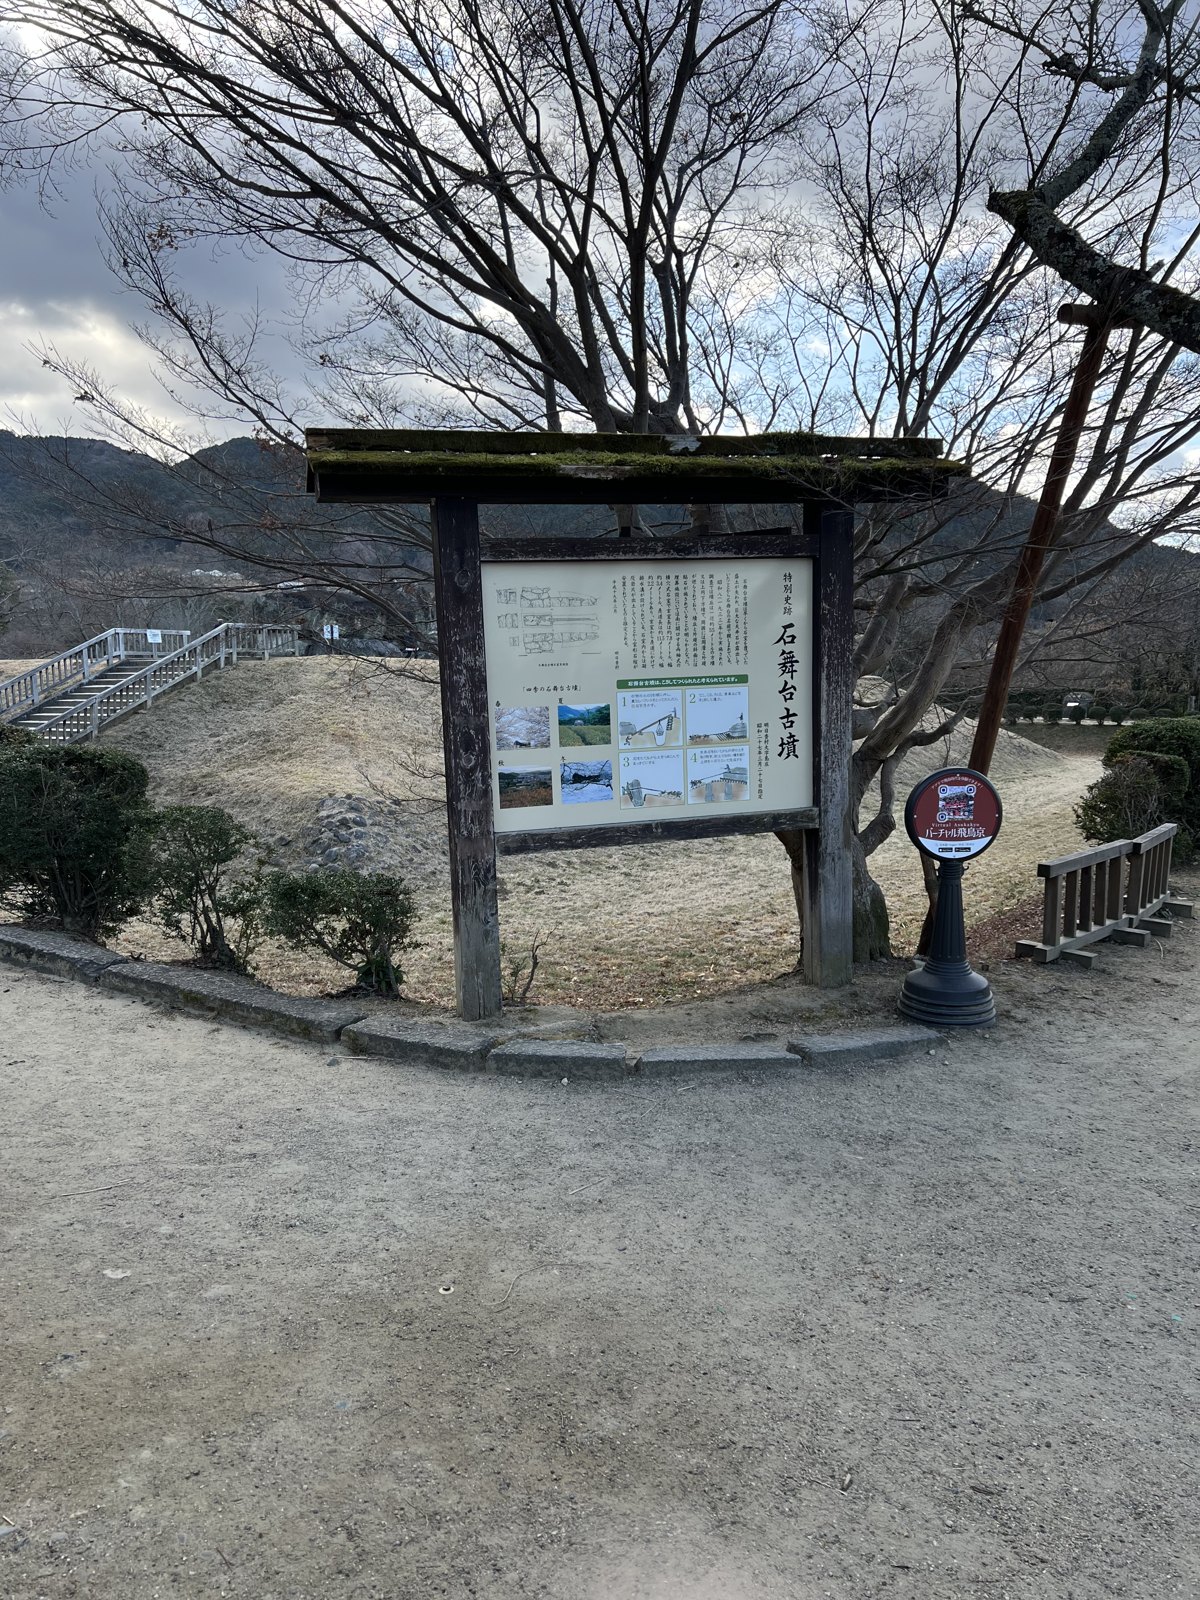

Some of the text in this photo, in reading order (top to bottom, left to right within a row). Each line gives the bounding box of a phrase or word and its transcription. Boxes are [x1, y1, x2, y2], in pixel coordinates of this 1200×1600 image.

[771, 571, 800, 760] 特別史跡 石舞台古墳
[622, 696, 627, 707] 1
[689, 693, 696, 704] 2
[623, 757, 630, 767] 3
[690, 752, 697, 763] 4
[925, 827, 986, 838] バーチャル飛鳥京
